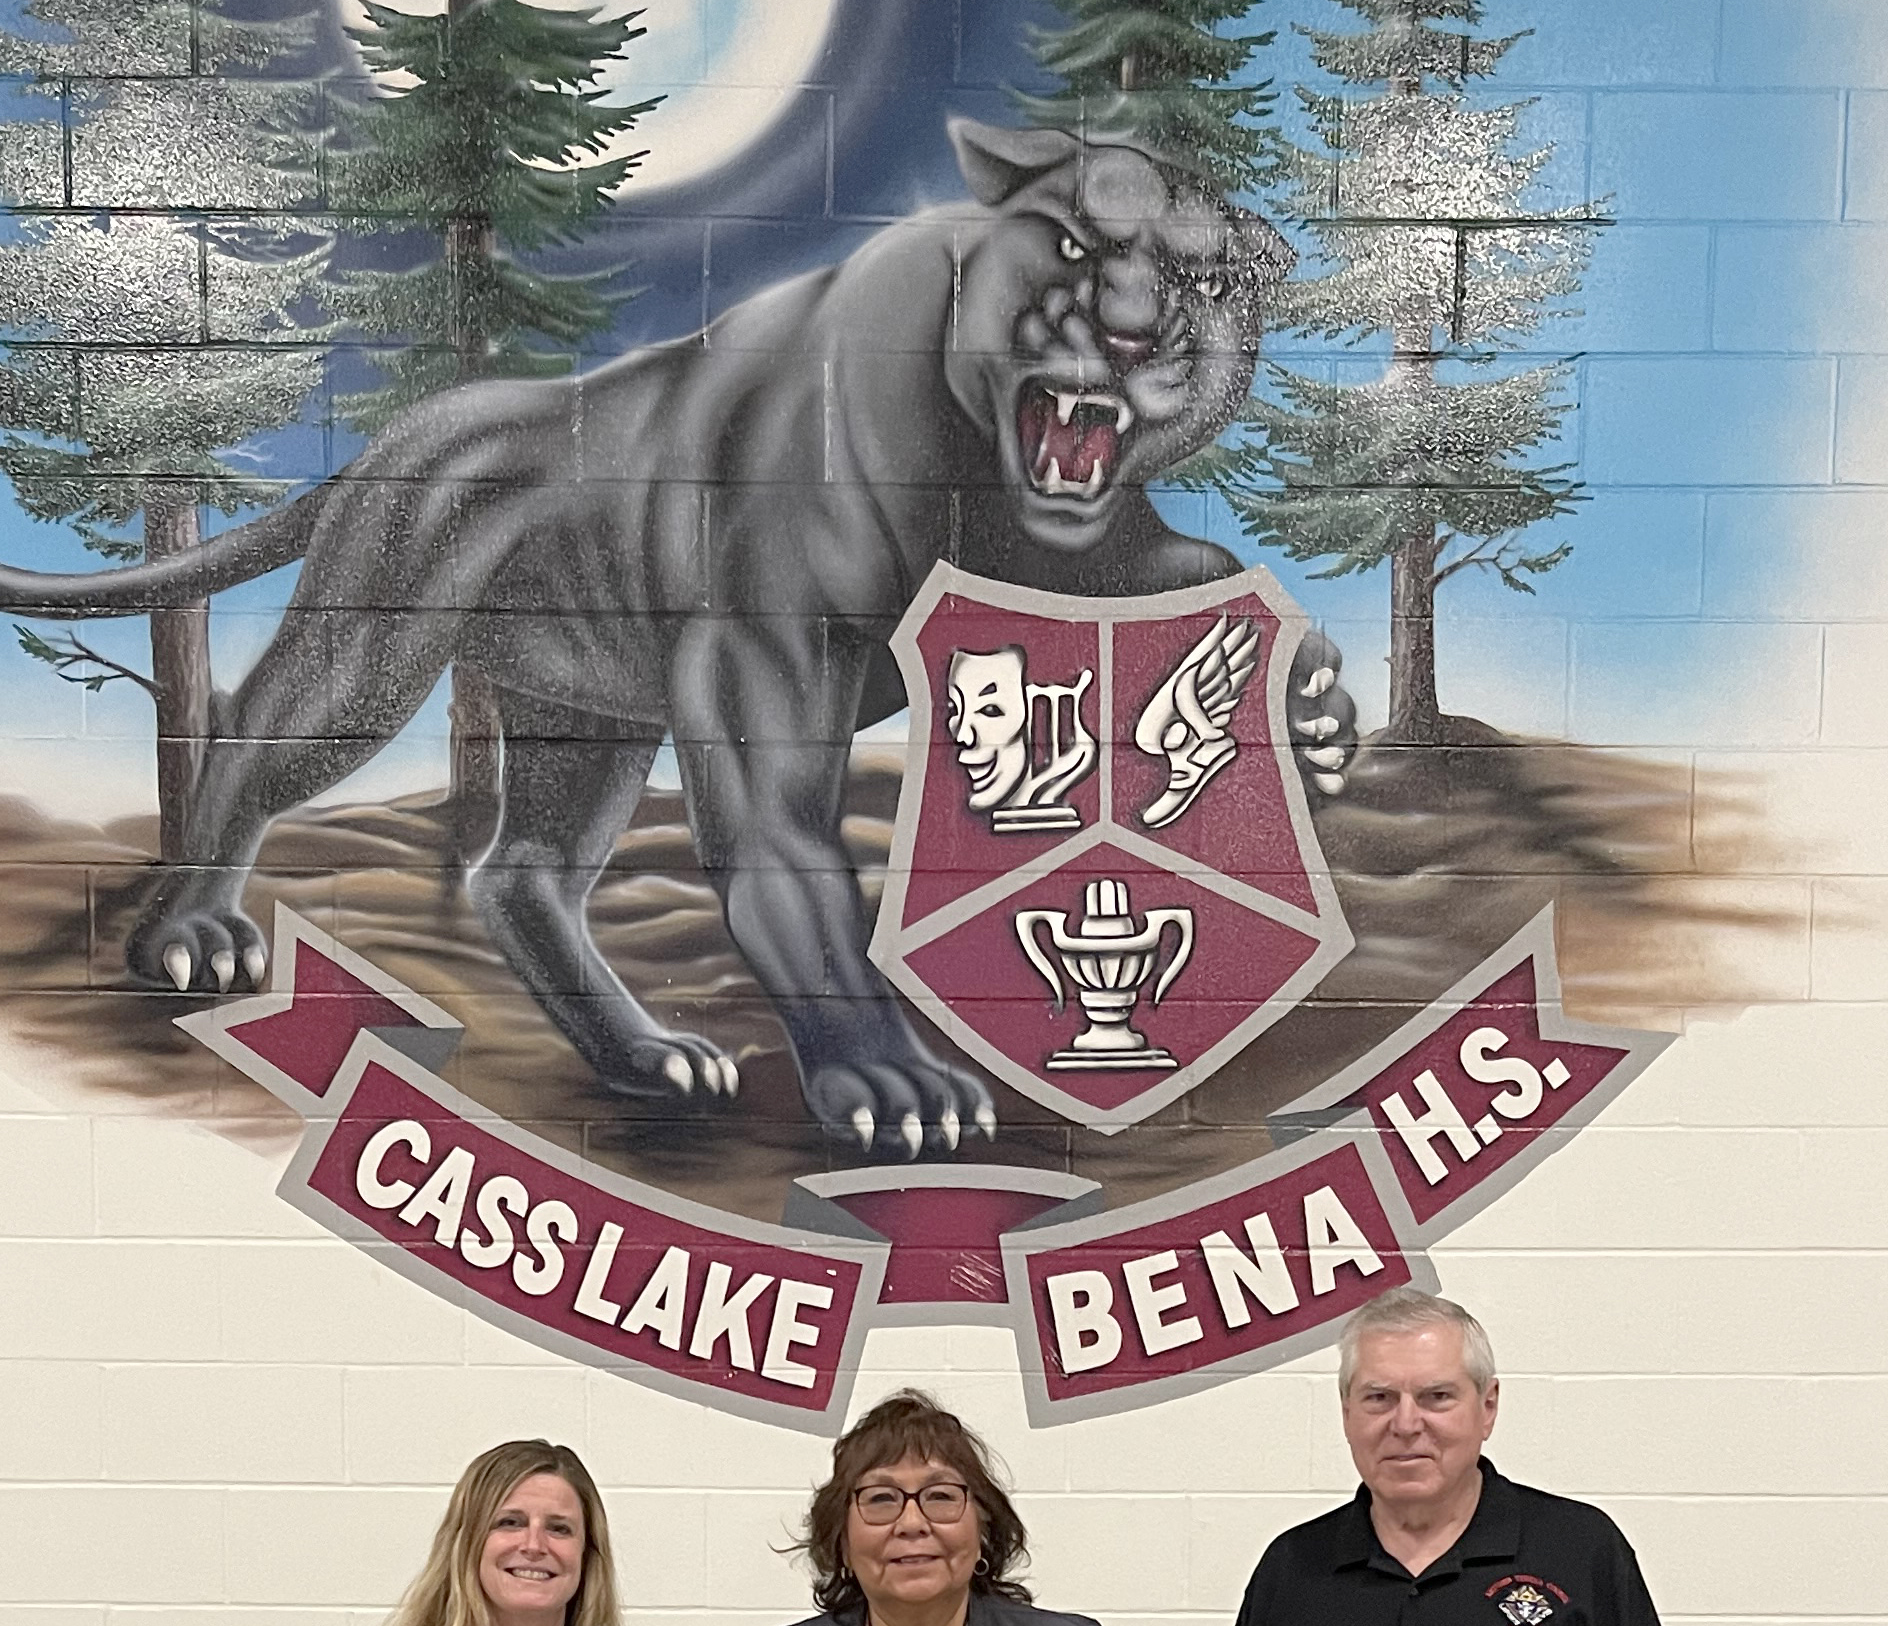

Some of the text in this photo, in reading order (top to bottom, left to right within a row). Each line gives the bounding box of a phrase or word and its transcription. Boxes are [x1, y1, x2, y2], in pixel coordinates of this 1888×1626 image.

[355, 1026, 1572, 1390] CASS LAKE BENA H.S.
